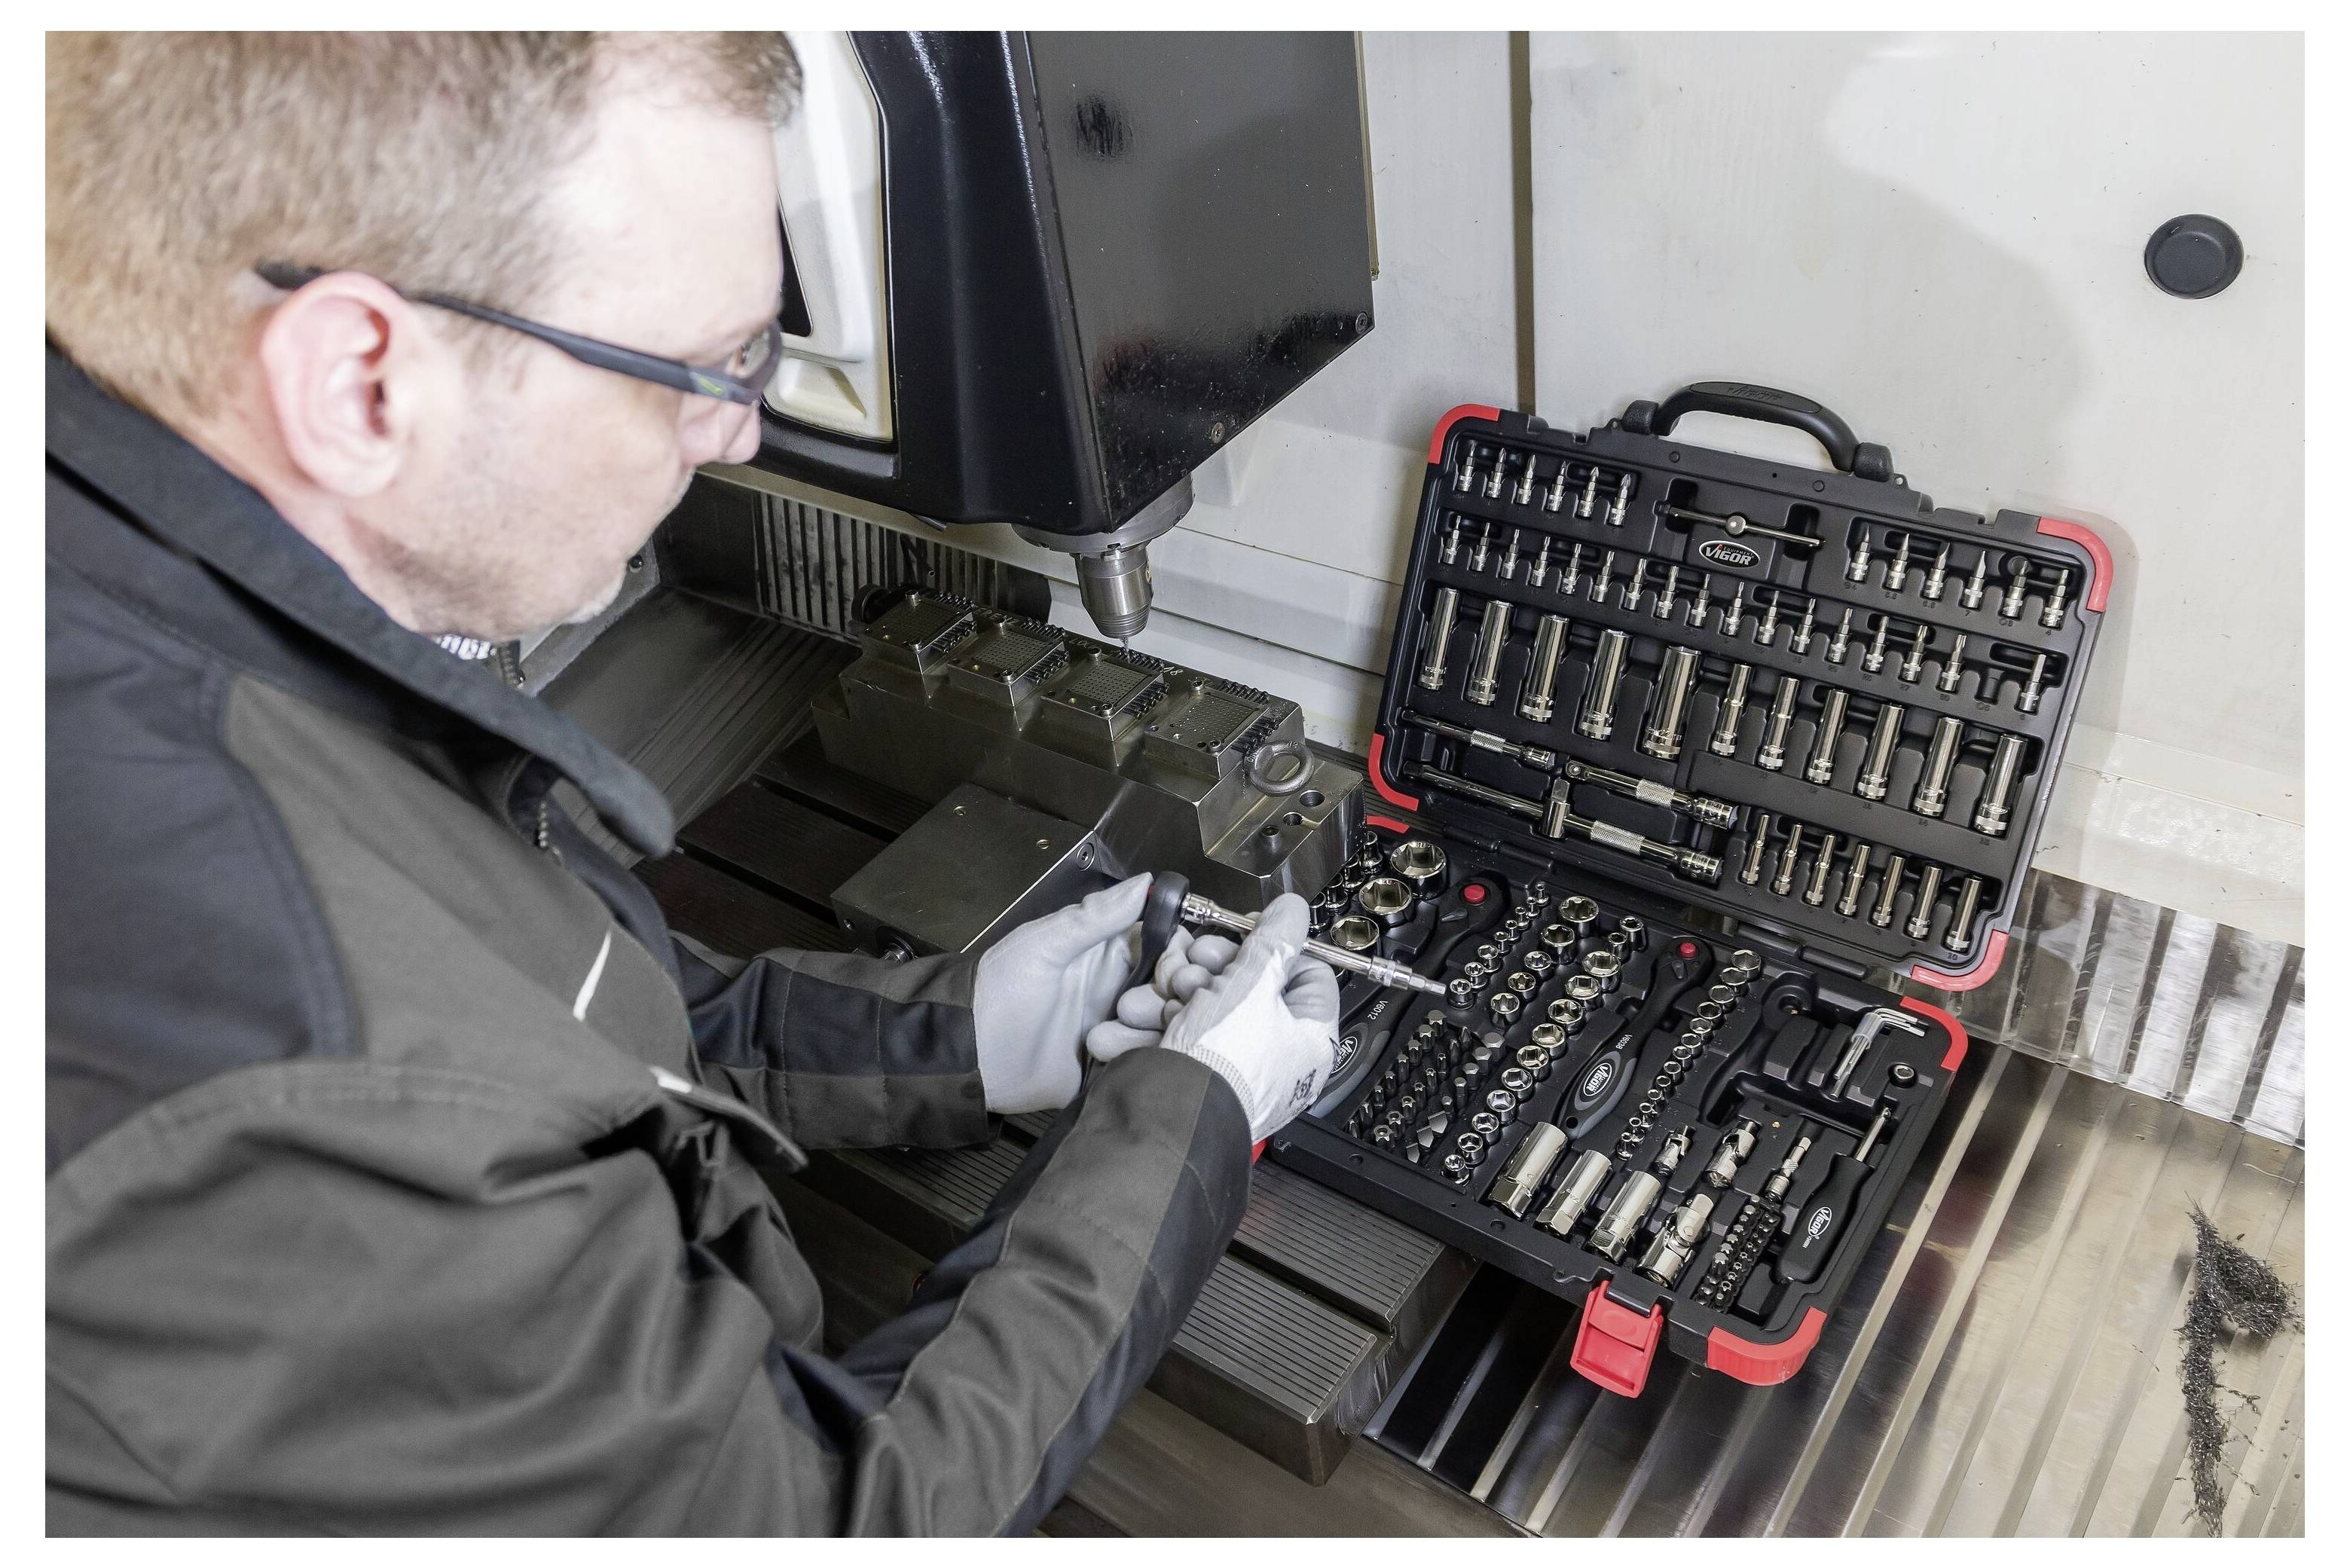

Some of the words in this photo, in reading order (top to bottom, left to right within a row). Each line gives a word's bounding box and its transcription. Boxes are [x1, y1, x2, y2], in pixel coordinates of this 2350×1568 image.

[1705, 544, 1752, 565] VIGOR
[1723, 546, 1753, 556] EQUIPMENT
[1368, 1000, 1389, 1020] V6012
[1615, 1034, 1633, 1050] V6038
[1586, 1065, 1609, 1093] VIGOR
[1810, 1209, 1830, 1234] VIGOR
